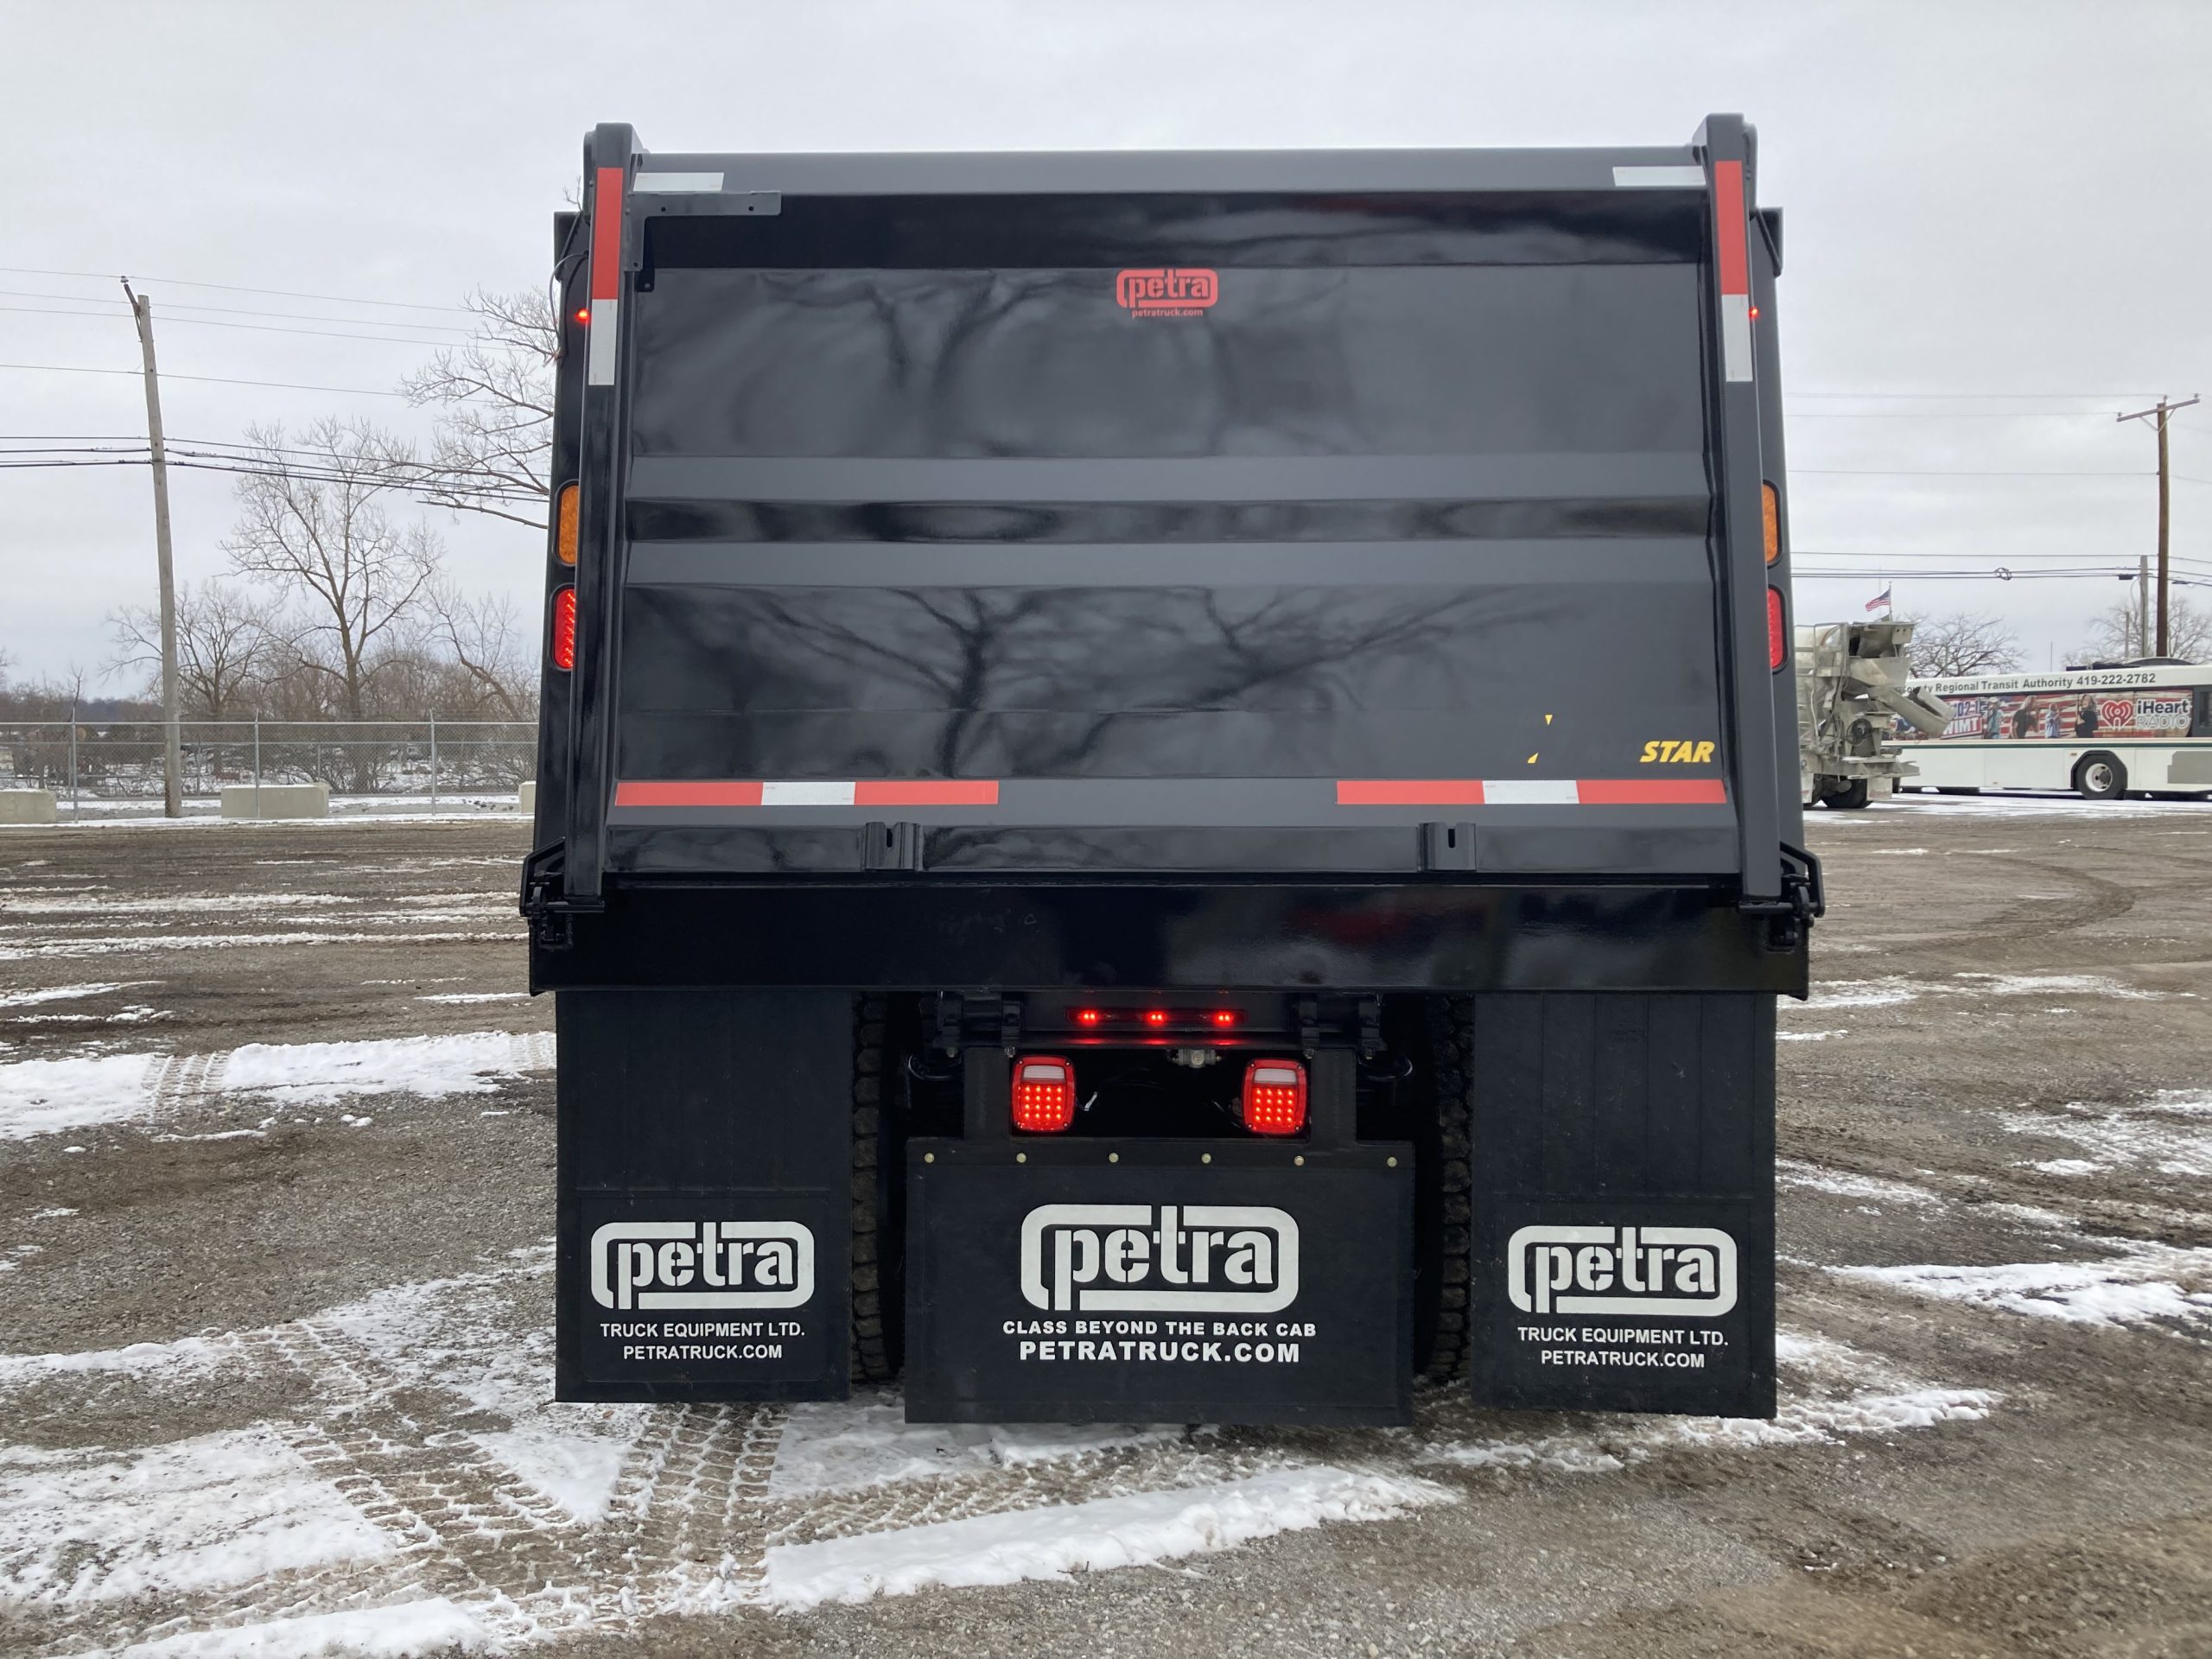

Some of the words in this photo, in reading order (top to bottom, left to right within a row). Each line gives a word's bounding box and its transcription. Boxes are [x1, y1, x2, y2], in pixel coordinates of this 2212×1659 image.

[1128, 269, 1209, 308] petra
[1132, 308, 1203, 318] petratruck.com
[1936, 682, 1979, 693] Regional
[1981, 680, 2018, 690] Transit
[2023, 677, 2073, 689] Authority
[2077, 673, 2156, 685] 419-222-2782
[2137, 699, 2190, 714] iHeart
[2136, 714, 2190, 729] RADIO
[1640, 741, 1715, 763] STAR
[618, 1222, 793, 1310] petra
[1054, 1205, 1273, 1311] petra
[1535, 1227, 1716, 1313] petra
[601, 1323, 658, 1338] TRUCK
[664, 1323, 763, 1338] EQUIPMENT
[768, 1322, 805, 1337] LTD.
[1002, 1321, 1067, 1335] CLASS
[1075, 1321, 1158, 1335] BEYOND
[1166, 1321, 1205, 1335] THE
[1213, 1322, 1268, 1337] BACK
[1275, 1323, 1316, 1338] CAB
[1517, 1326, 1577, 1342] TRUCK
[1582, 1328, 1684, 1344] EQUIPMENT
[1689, 1331, 1728, 1346] LTD.
[624, 1344, 782, 1360] PETRATRUCK.COM
[1020, 1341, 1300, 1363] PETRATRUCK.COM
[1541, 1350, 1705, 1368] PETRATRUCK.COM
